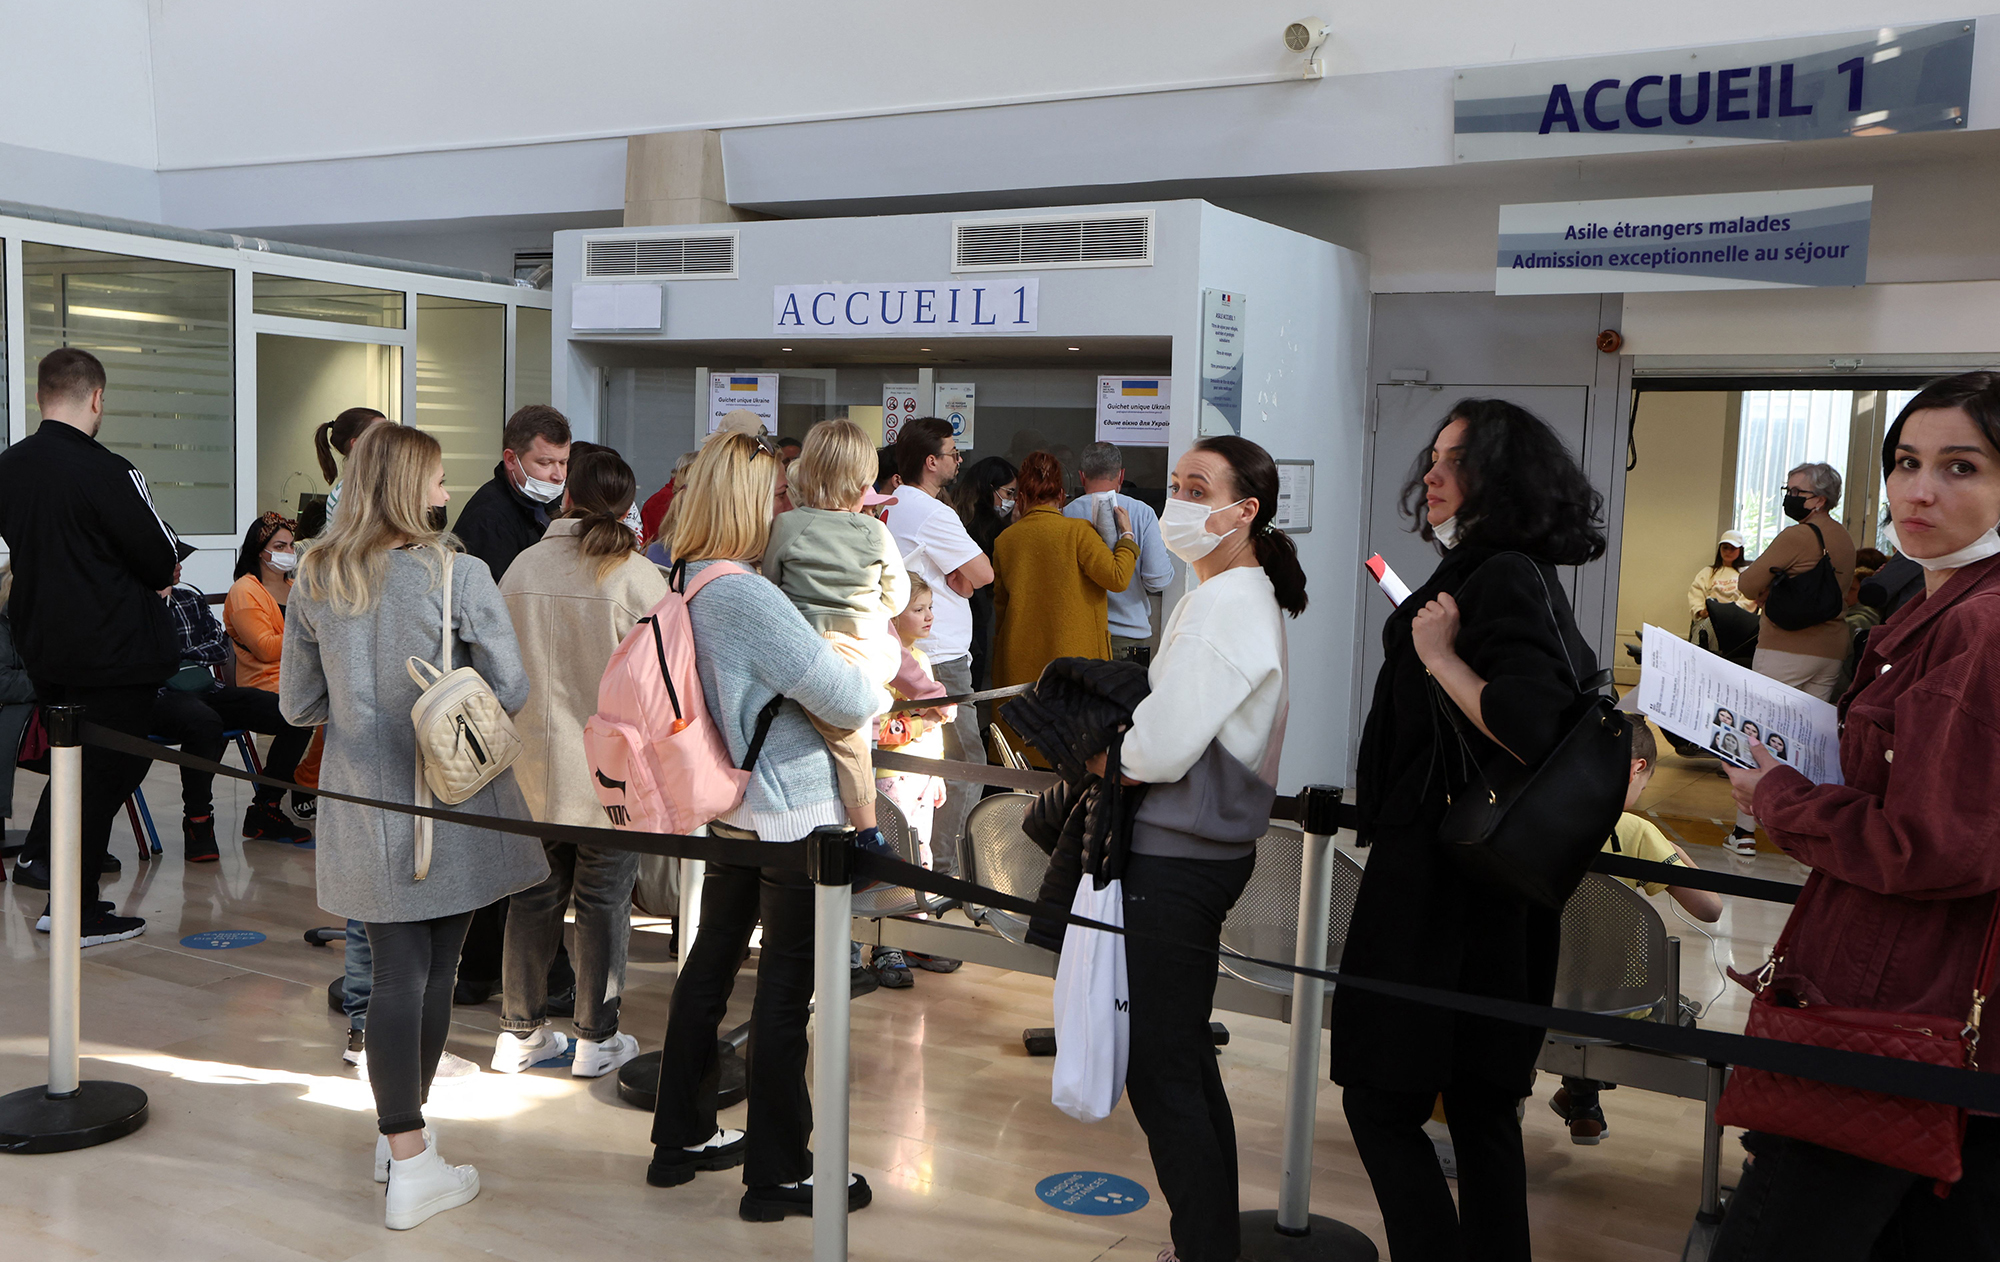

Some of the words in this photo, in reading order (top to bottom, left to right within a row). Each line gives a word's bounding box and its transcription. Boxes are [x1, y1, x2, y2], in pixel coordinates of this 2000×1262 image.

[1538, 63, 1813, 135] ACCUEIL
[1837, 56, 1865, 112] 1
[1564, 223, 1608, 240] Asile
[1613, 221, 1703, 240] étrangers
[1708, 215, 1791, 234] malades
[1512, 250, 1603, 269] Admission
[1608, 245, 1749, 268] exceptionnelle
[1754, 247, 1778, 261] au
[1784, 242, 1850, 264] séjour
[777, 288, 997, 326] ACCUEIL
[1012, 285, 1030, 324] 1
[1045, 1174, 1082, 1197] GARDONS
[1063, 1177, 1108, 1206] DISTANCES
[1064, 1182, 1084, 1194] NOS
